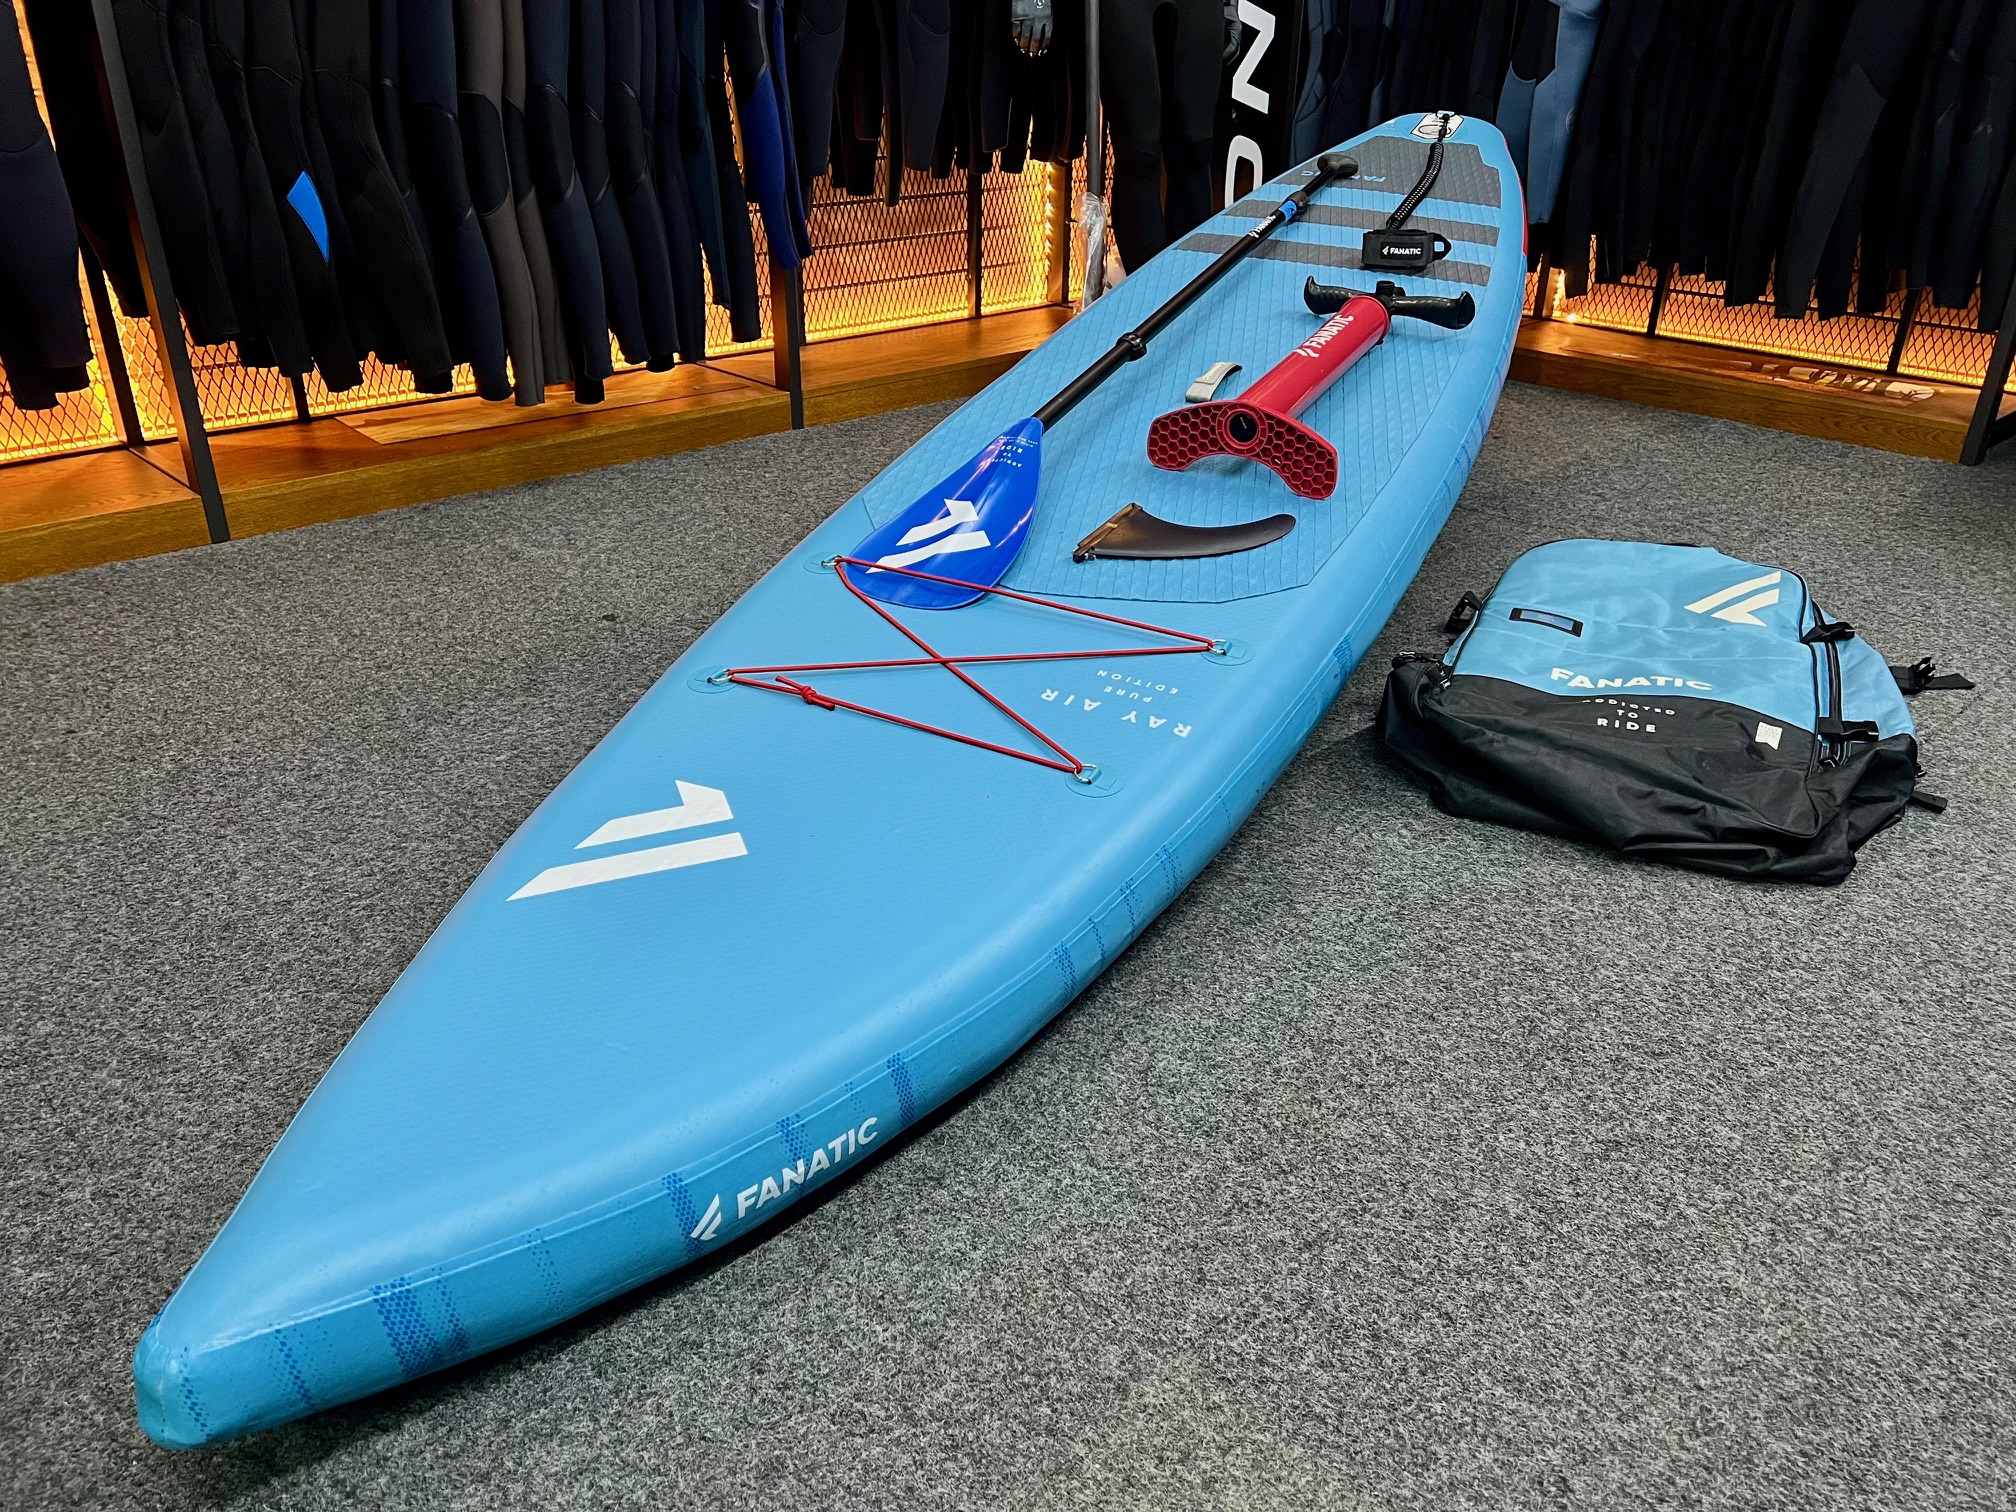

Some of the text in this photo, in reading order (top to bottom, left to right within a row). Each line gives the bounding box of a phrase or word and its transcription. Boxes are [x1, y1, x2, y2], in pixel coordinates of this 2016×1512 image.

[1390, 246, 1422, 255] FANATIC
[1302, 314, 1354, 349] FANATIC
[1097, 669, 1179, 695] EDITION
[1550, 667, 1713, 691] FANATIC
[1103, 685, 1152, 703] PURE
[1040, 688, 1192, 738] RAY AIR
[1597, 717, 1656, 733] RIDE
[1616, 709, 1639, 719] TO
[737, 1117, 878, 1219] FANATIC
